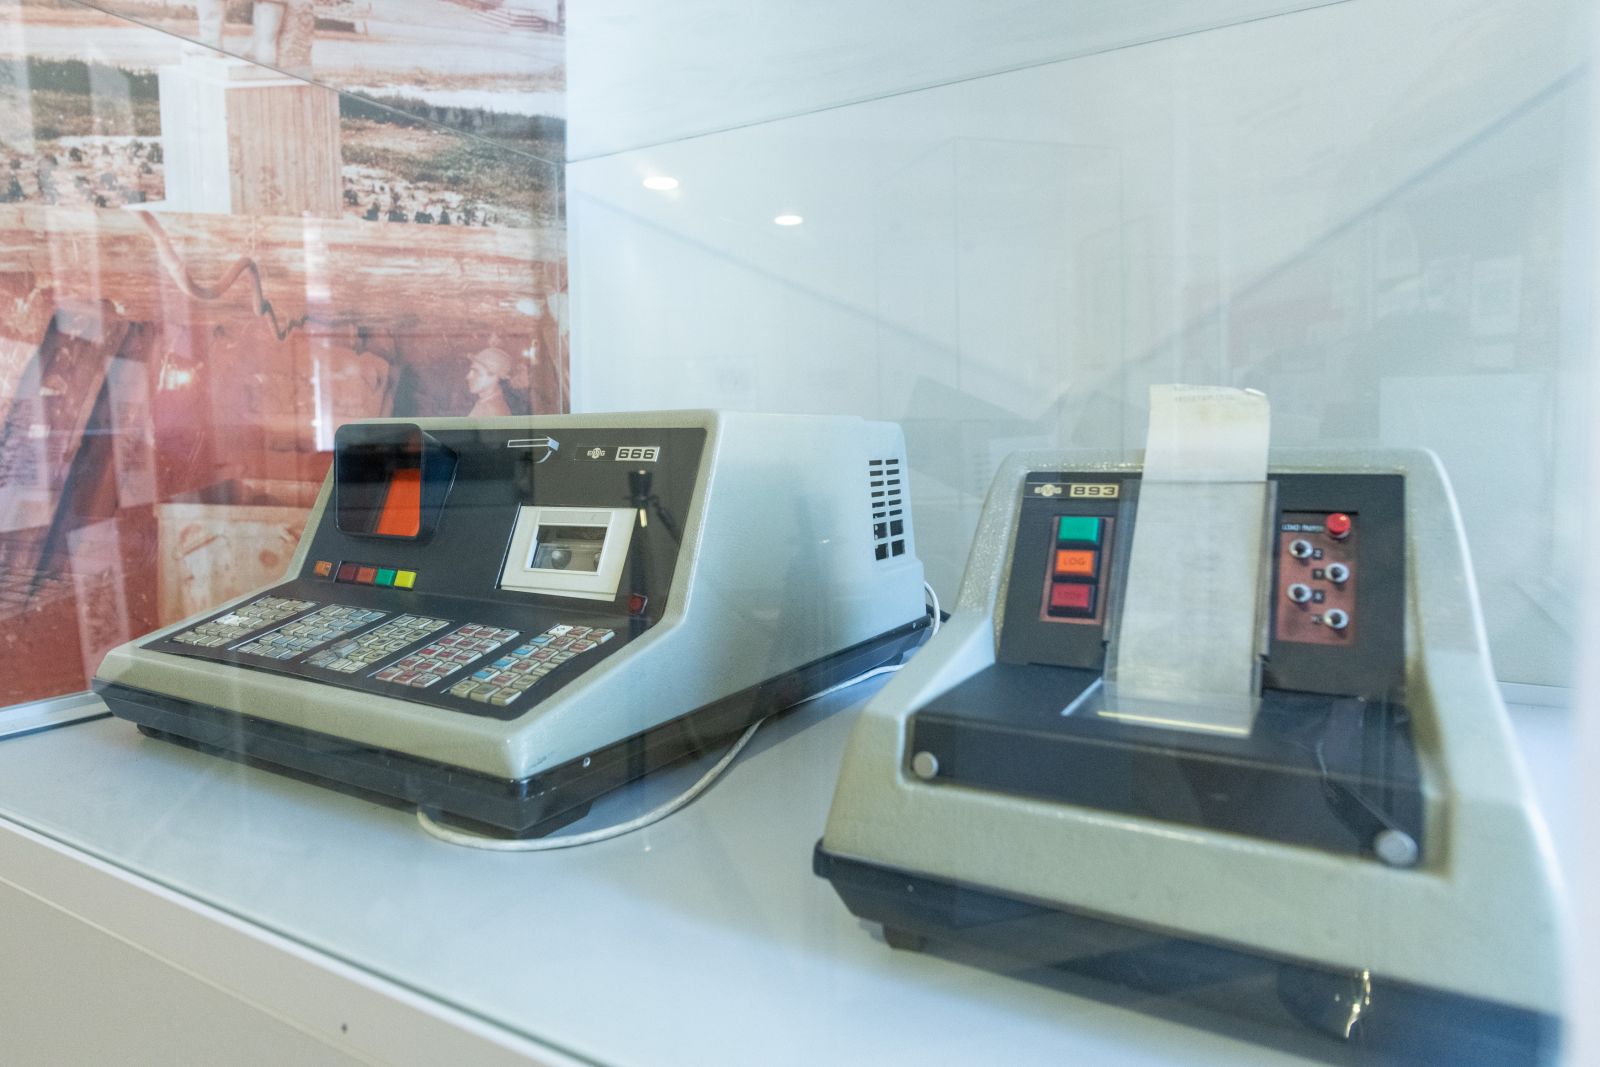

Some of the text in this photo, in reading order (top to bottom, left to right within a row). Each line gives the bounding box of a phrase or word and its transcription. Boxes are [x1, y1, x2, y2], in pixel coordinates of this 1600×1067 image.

[618, 448, 655, 459] 666
[1073, 486, 1116, 496] 893
[1063, 556, 1088, 566] LOG
